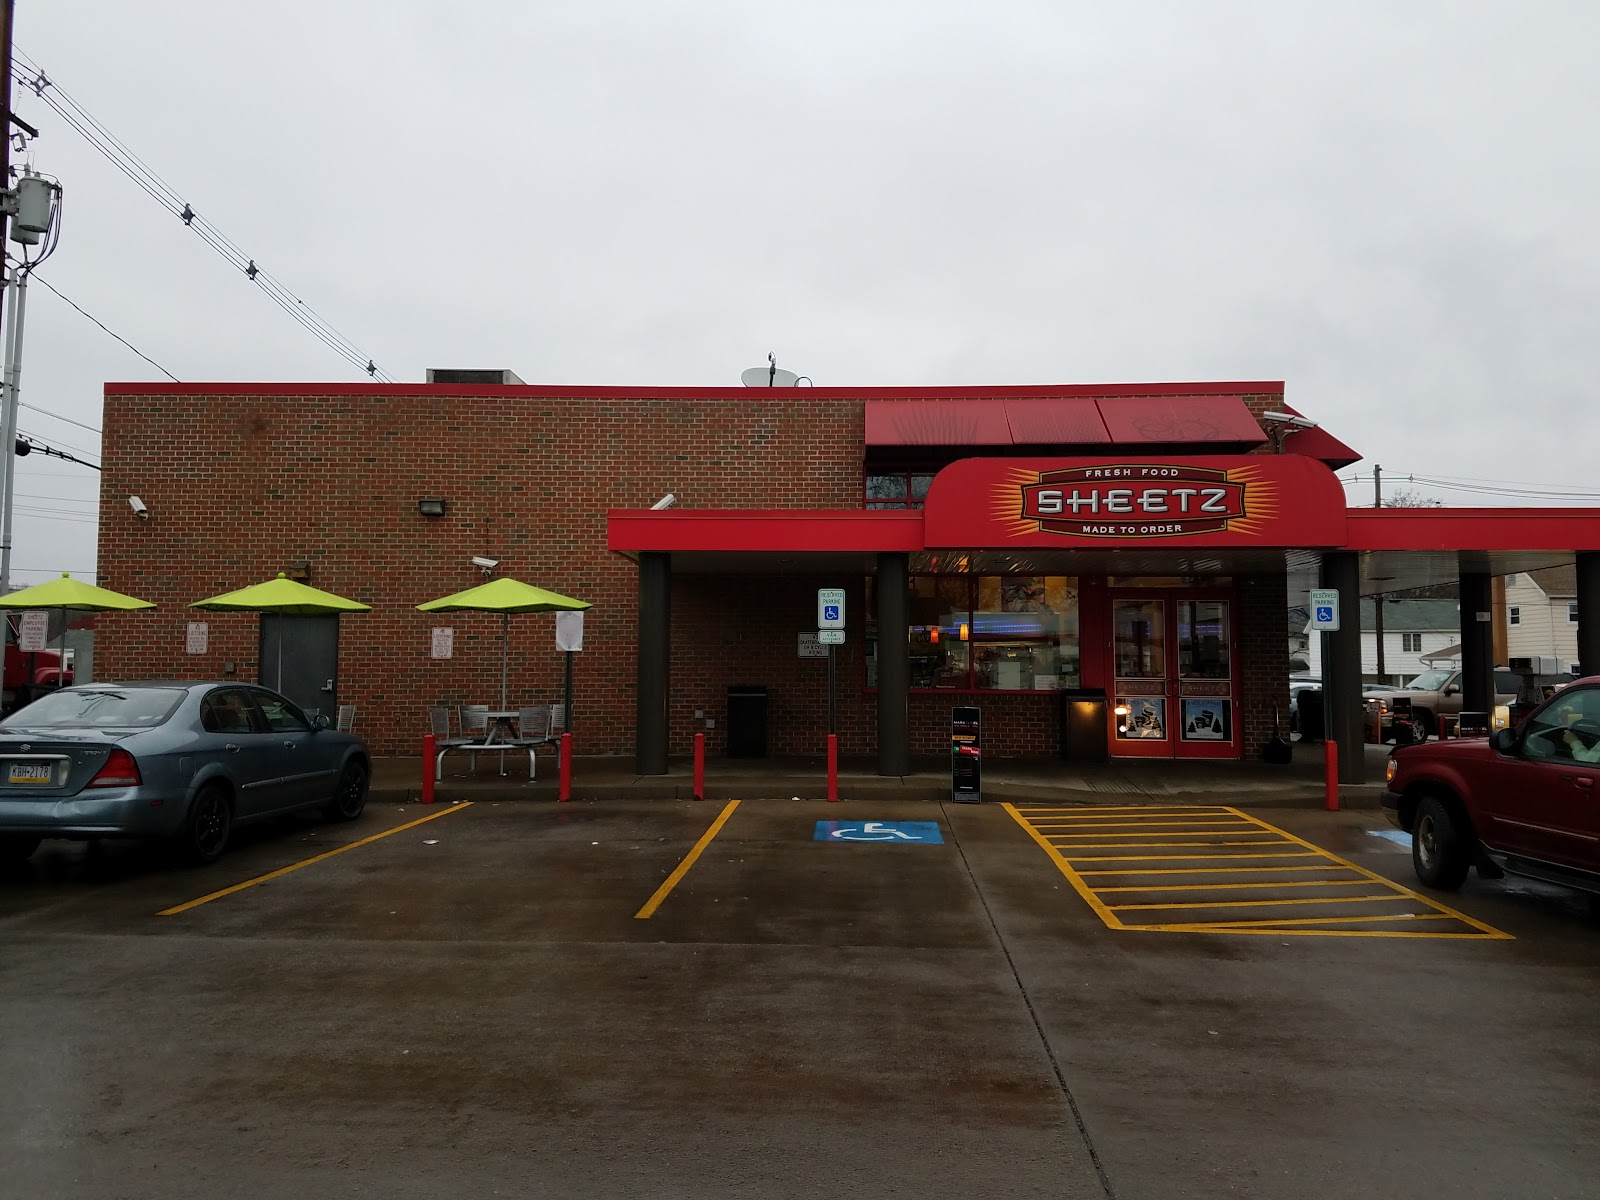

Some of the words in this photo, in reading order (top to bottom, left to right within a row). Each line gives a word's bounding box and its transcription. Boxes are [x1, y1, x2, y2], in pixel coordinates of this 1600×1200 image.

[1085, 468, 1131, 478] FRESH
[1141, 468, 1179, 477] FOOD
[1038, 488, 1227, 514] SHEETZ
[1082, 525, 1116, 534] MADE
[1120, 526, 1136, 534] TO
[1140, 524, 1182, 534] ORDER
